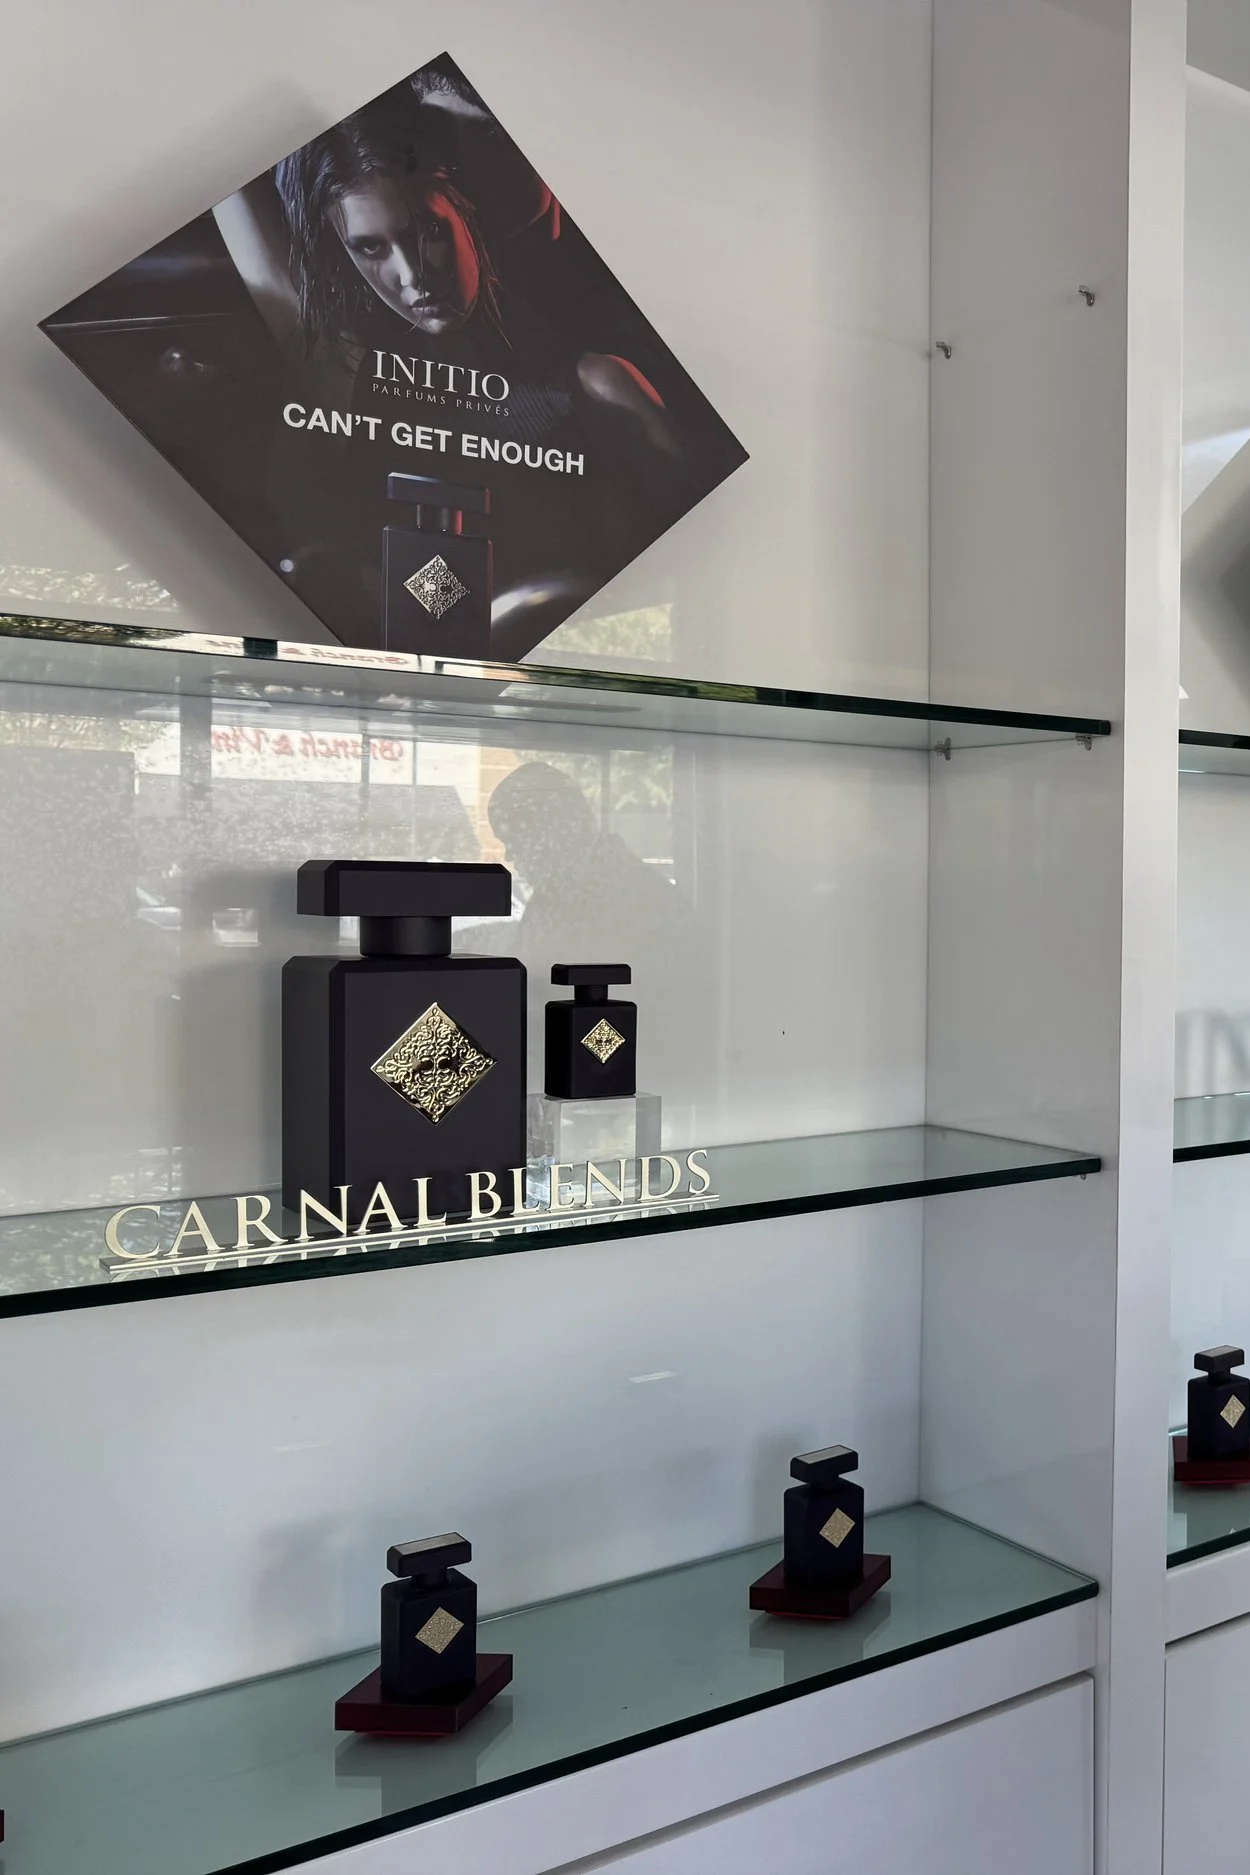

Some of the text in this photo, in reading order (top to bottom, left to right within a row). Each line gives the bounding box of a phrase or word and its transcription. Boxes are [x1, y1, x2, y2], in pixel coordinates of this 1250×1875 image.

[372, 349, 510, 402] INITIO
[372, 383, 510, 417] PARFUMS PRIVÉS
[283, 403, 585, 476] CAN'T GET ENOUGH
[104, 1148, 712, 1260] CARNAL BLENDS
